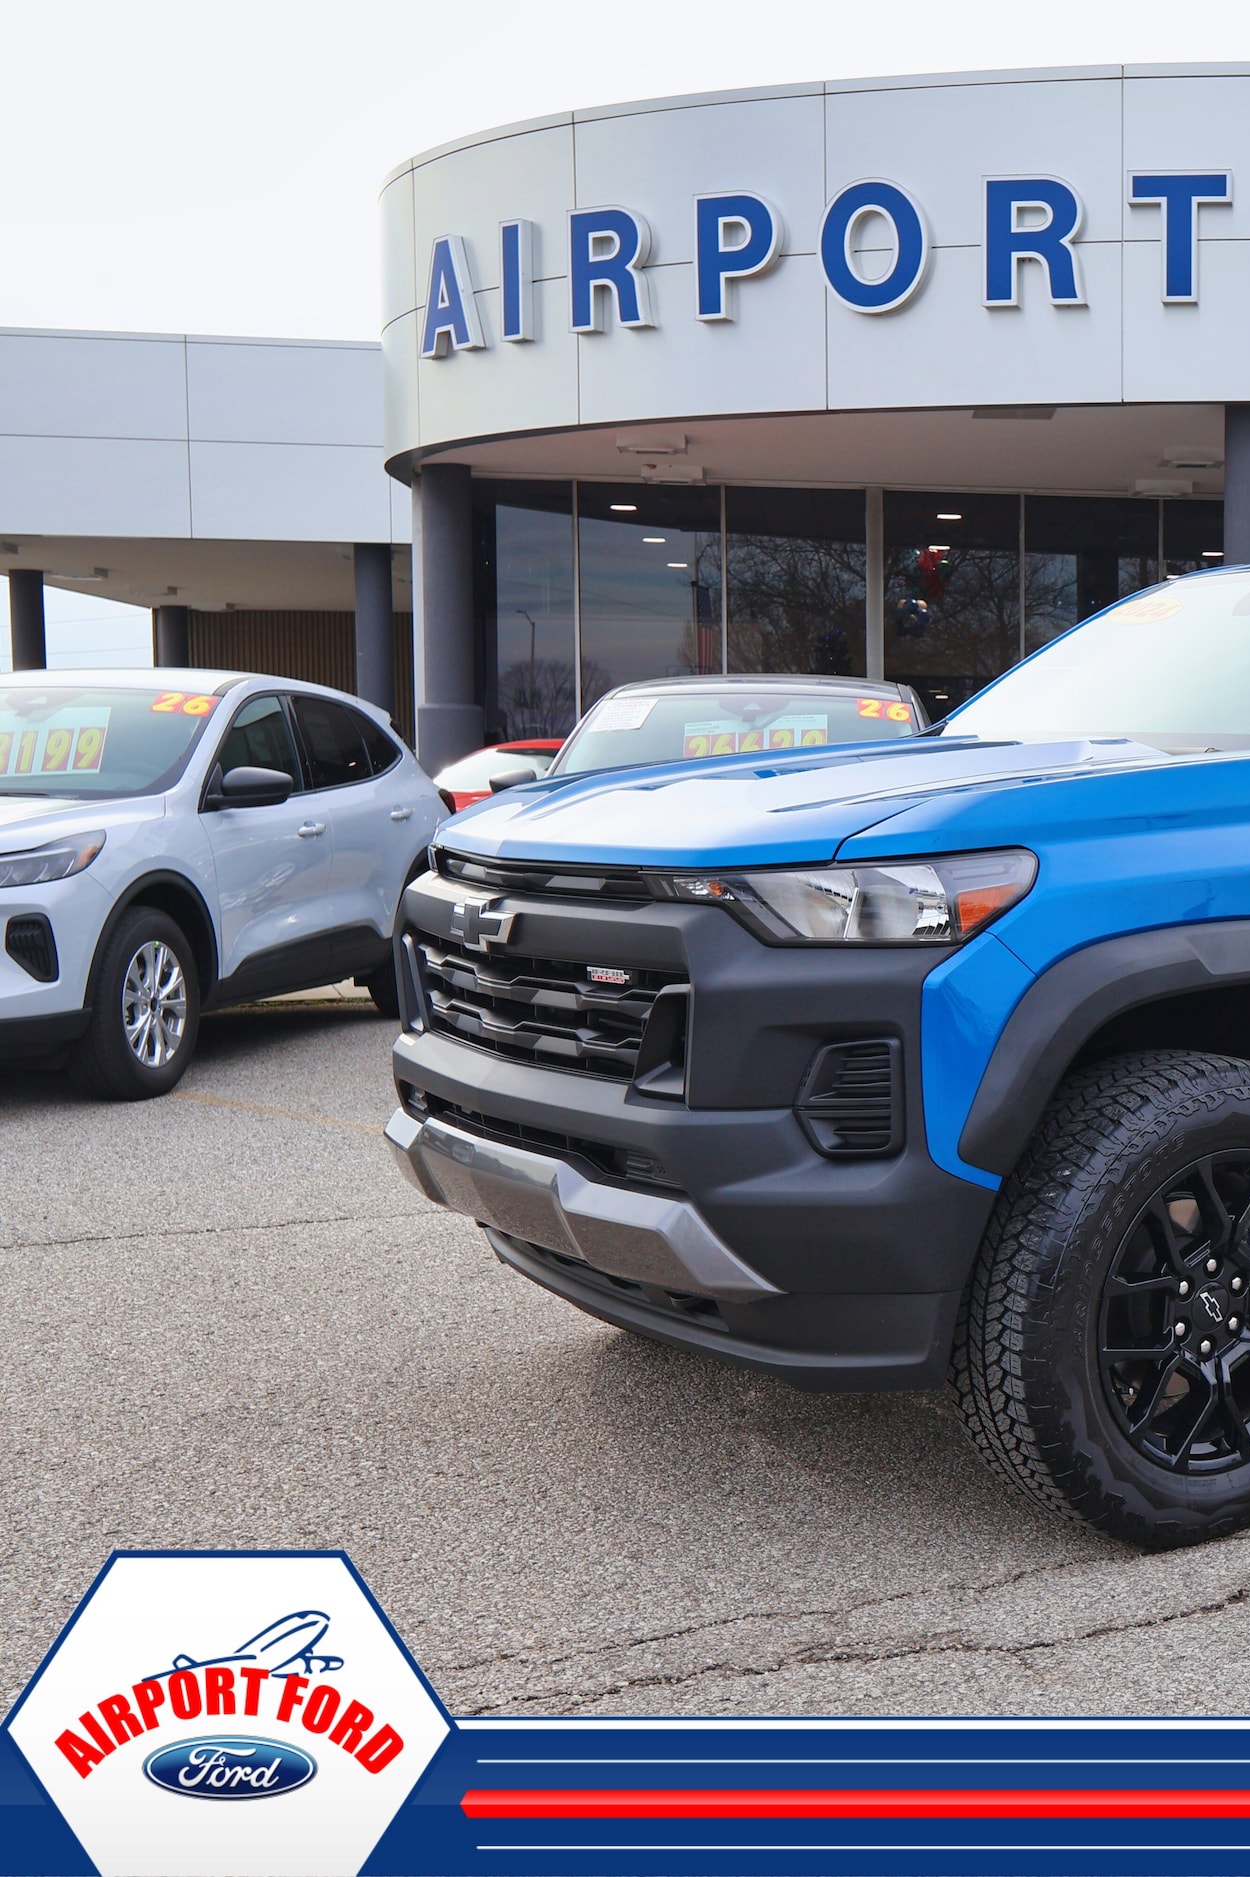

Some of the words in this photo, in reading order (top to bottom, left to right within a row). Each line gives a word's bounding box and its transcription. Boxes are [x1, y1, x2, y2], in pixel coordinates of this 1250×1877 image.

[419, 169, 1233, 360] AIRPORT
[152, 692, 212, 715] 26
[859, 699, 910, 722] 26
